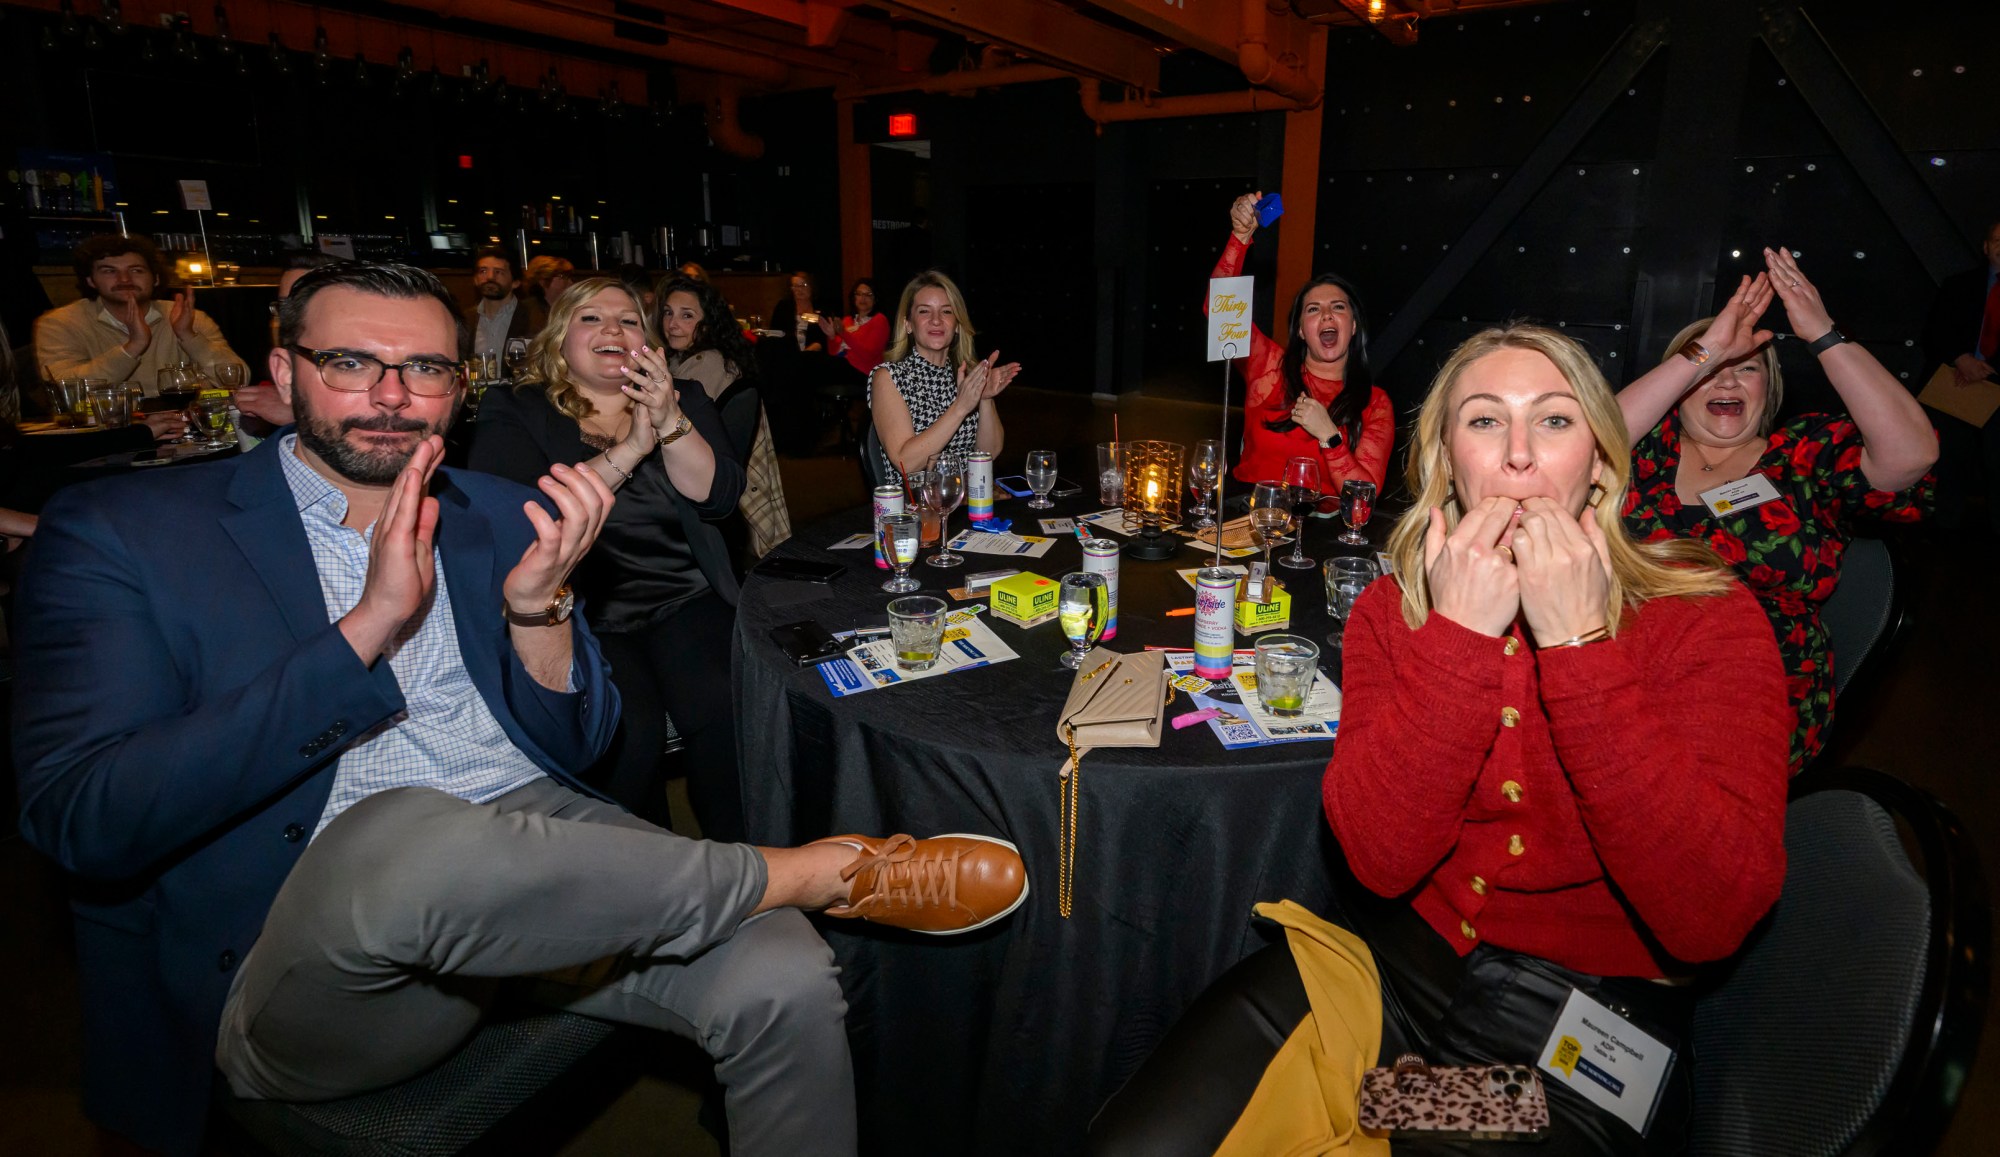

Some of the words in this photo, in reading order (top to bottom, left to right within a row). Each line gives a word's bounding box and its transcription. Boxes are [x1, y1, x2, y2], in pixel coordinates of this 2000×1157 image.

[1212, 293, 1248, 318] Thirty
[1218, 322, 1249, 341] Four
[999, 592, 1017, 606] ULINE
[1034, 592, 1053, 605] ULINE
[1257, 602, 1280, 614] ULINE
[1564, 1040, 1579, 1052] TOP
[1581, 1017, 1610, 1040] Maureen
[1610, 1035, 1645, 1062] Campbell
